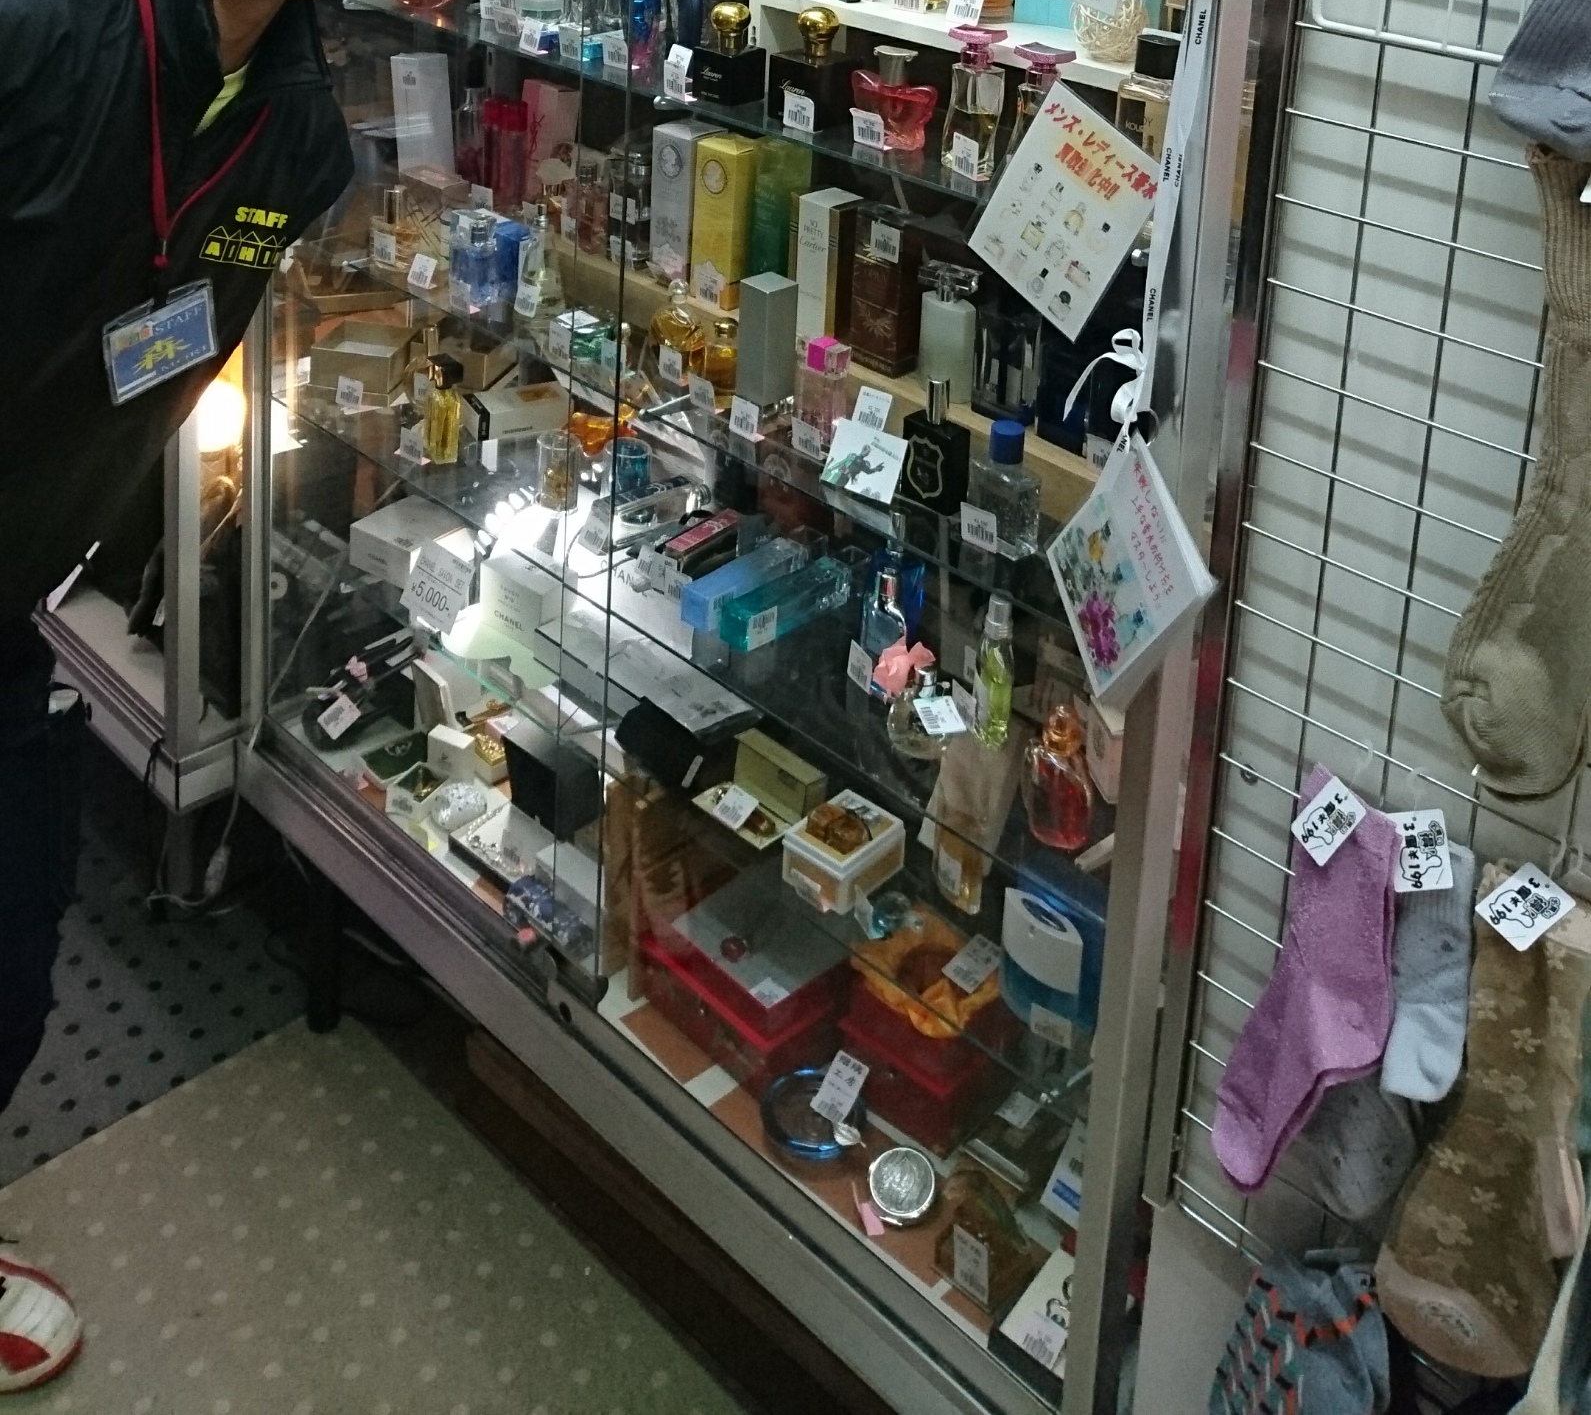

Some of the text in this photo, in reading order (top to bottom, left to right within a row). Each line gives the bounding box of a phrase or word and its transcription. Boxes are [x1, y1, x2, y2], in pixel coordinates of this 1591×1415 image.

[1195, 9, 1207, 45] CHANEL
[1043, 101, 1159, 200] メンズ・レディース香水
[1162, 147, 1172, 182] CHANEL
[235, 206, 288, 230] STAFF
[1146, 287, 1156, 322] CHANEL
[494, 609, 525, 632] CHANEL
